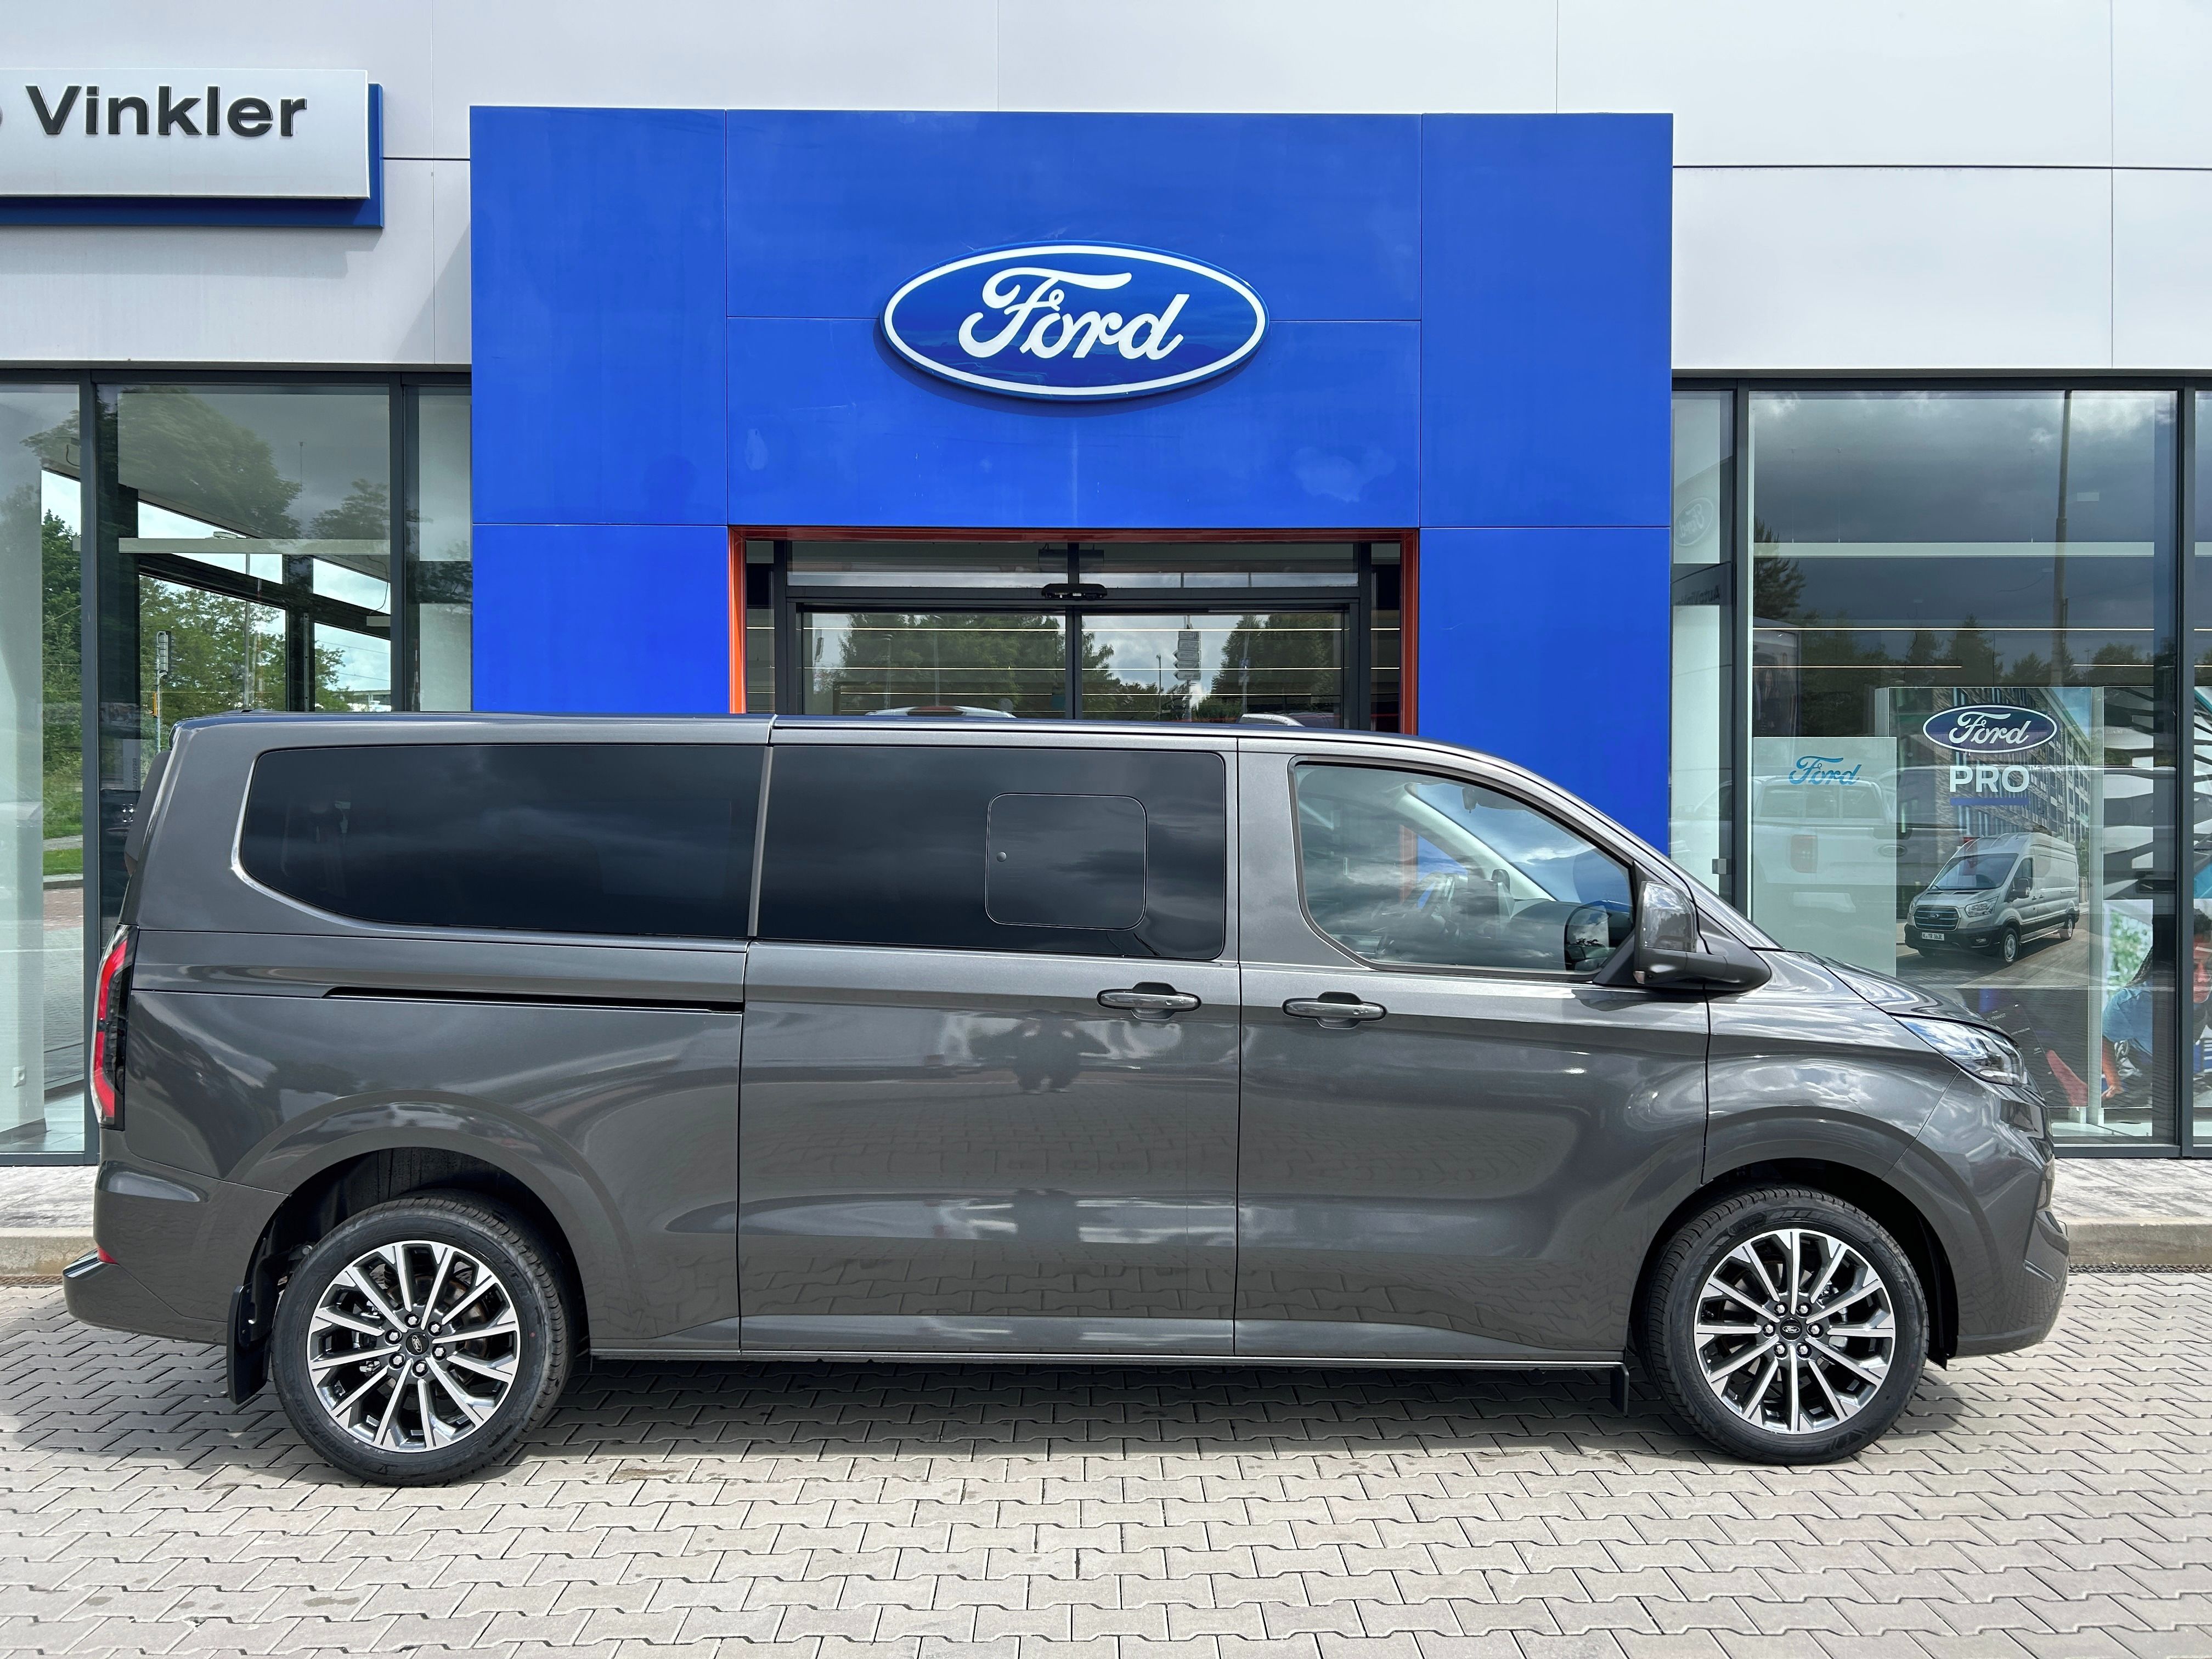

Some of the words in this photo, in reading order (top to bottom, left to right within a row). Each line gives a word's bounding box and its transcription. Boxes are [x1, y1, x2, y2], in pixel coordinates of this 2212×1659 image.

[25, 85, 307, 137] Vinkler
[958, 267, 1190, 360] Ford
[1949, 711, 2032, 744] Ford
[1788, 756, 1861, 785] Ford
